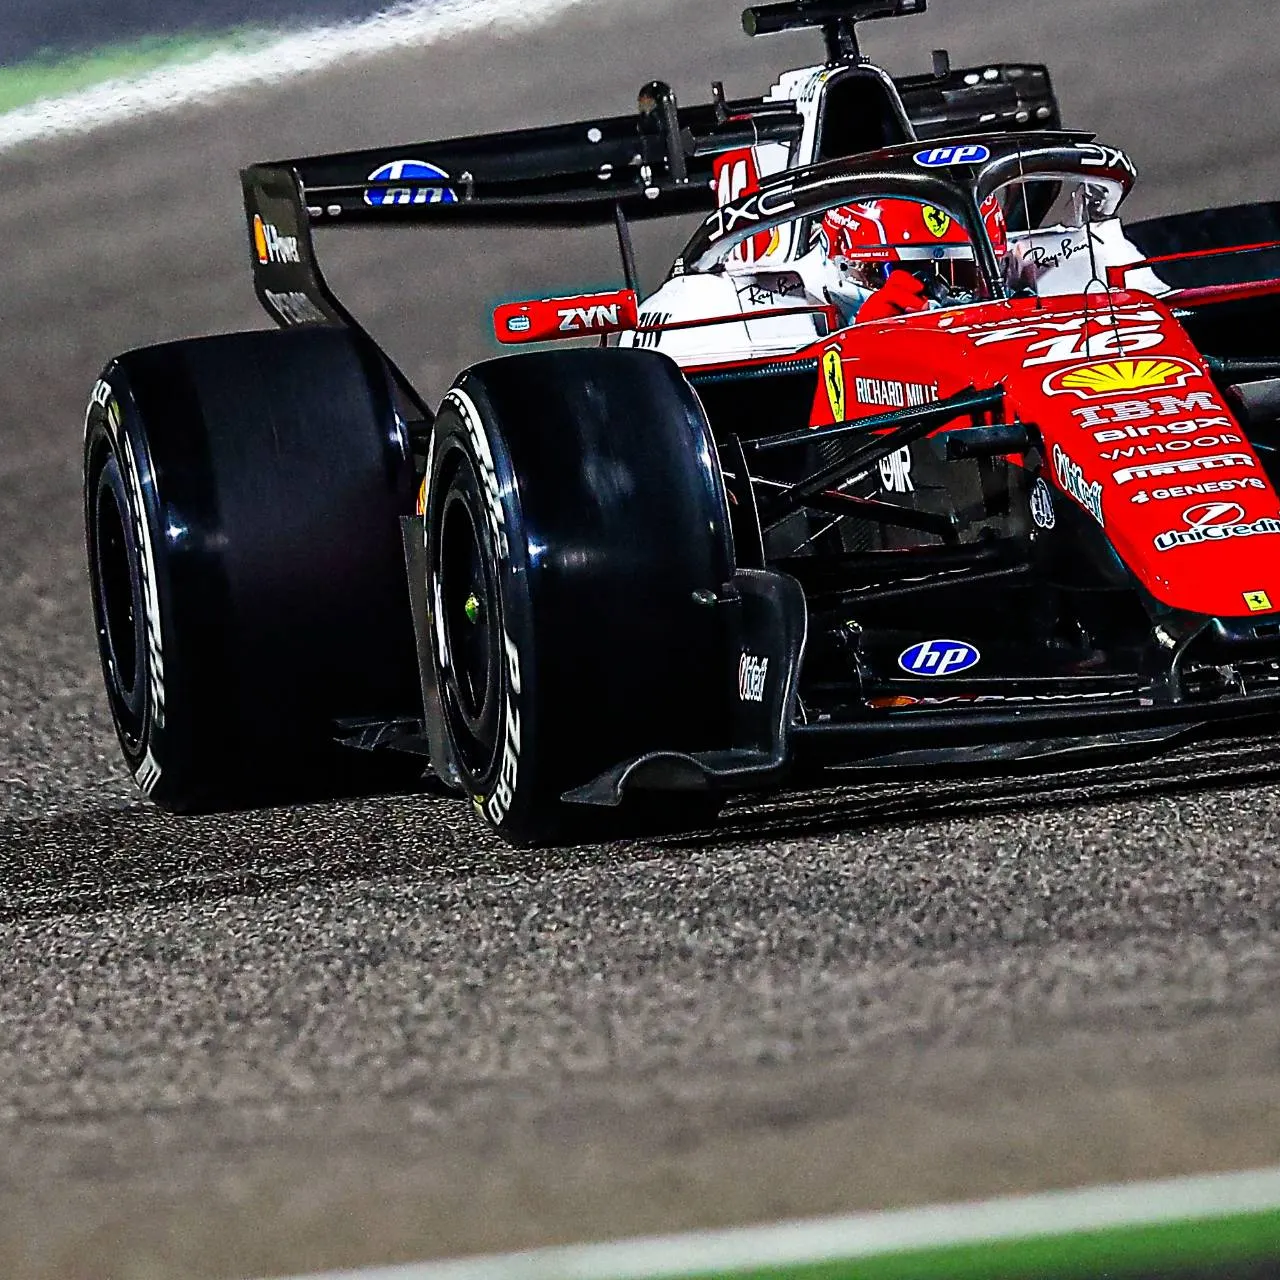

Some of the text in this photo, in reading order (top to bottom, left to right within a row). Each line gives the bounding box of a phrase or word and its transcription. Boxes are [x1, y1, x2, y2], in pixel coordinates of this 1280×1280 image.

[926, 144, 979, 166] hp
[557, 303, 619, 331] ZYN
[967, 309, 1165, 347] ZYN
[1022, 324, 1165, 368] 16
[855, 377, 905, 408] RICHARD
[1071, 391, 1222, 429] IBM
[1093, 415, 1232, 443] BingX
[1099, 433, 1242, 461] WHOOP
[1112, 452, 1255, 485] PIRELLI
[1151, 477, 1267, 500] GENESYS
[911, 641, 969, 675] hp
